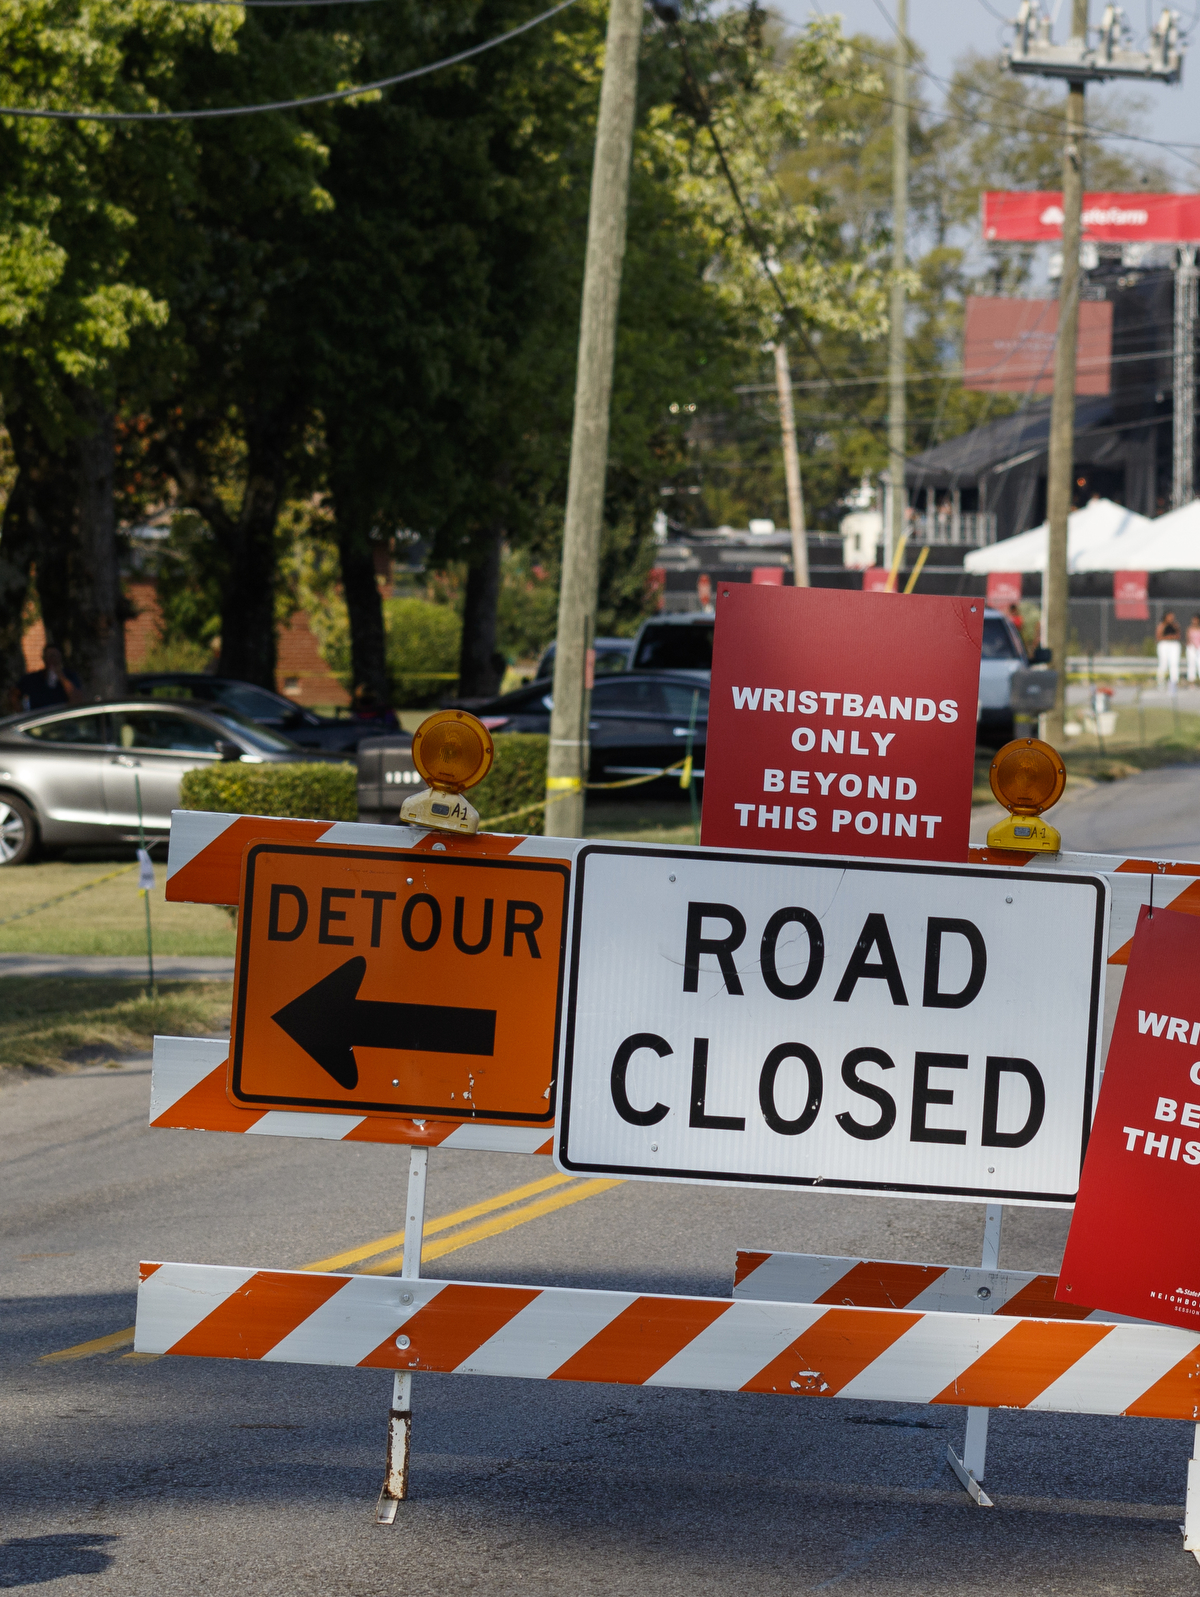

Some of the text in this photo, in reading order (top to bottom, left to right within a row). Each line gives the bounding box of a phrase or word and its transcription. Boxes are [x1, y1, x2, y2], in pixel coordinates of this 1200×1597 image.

[731, 686, 959, 723] WRISTBANDS
[791, 727, 896, 757] ONLY
[763, 768, 917, 801] BEYOND
[451, 803, 468, 820] A-1
[734, 803, 942, 839] THIS POINT
[1031, 826, 1046, 838] A-1
[267, 883, 544, 959] DETOUR
[682, 901, 987, 1009] ROAD
[610, 1032, 1046, 1149] CLOSED
